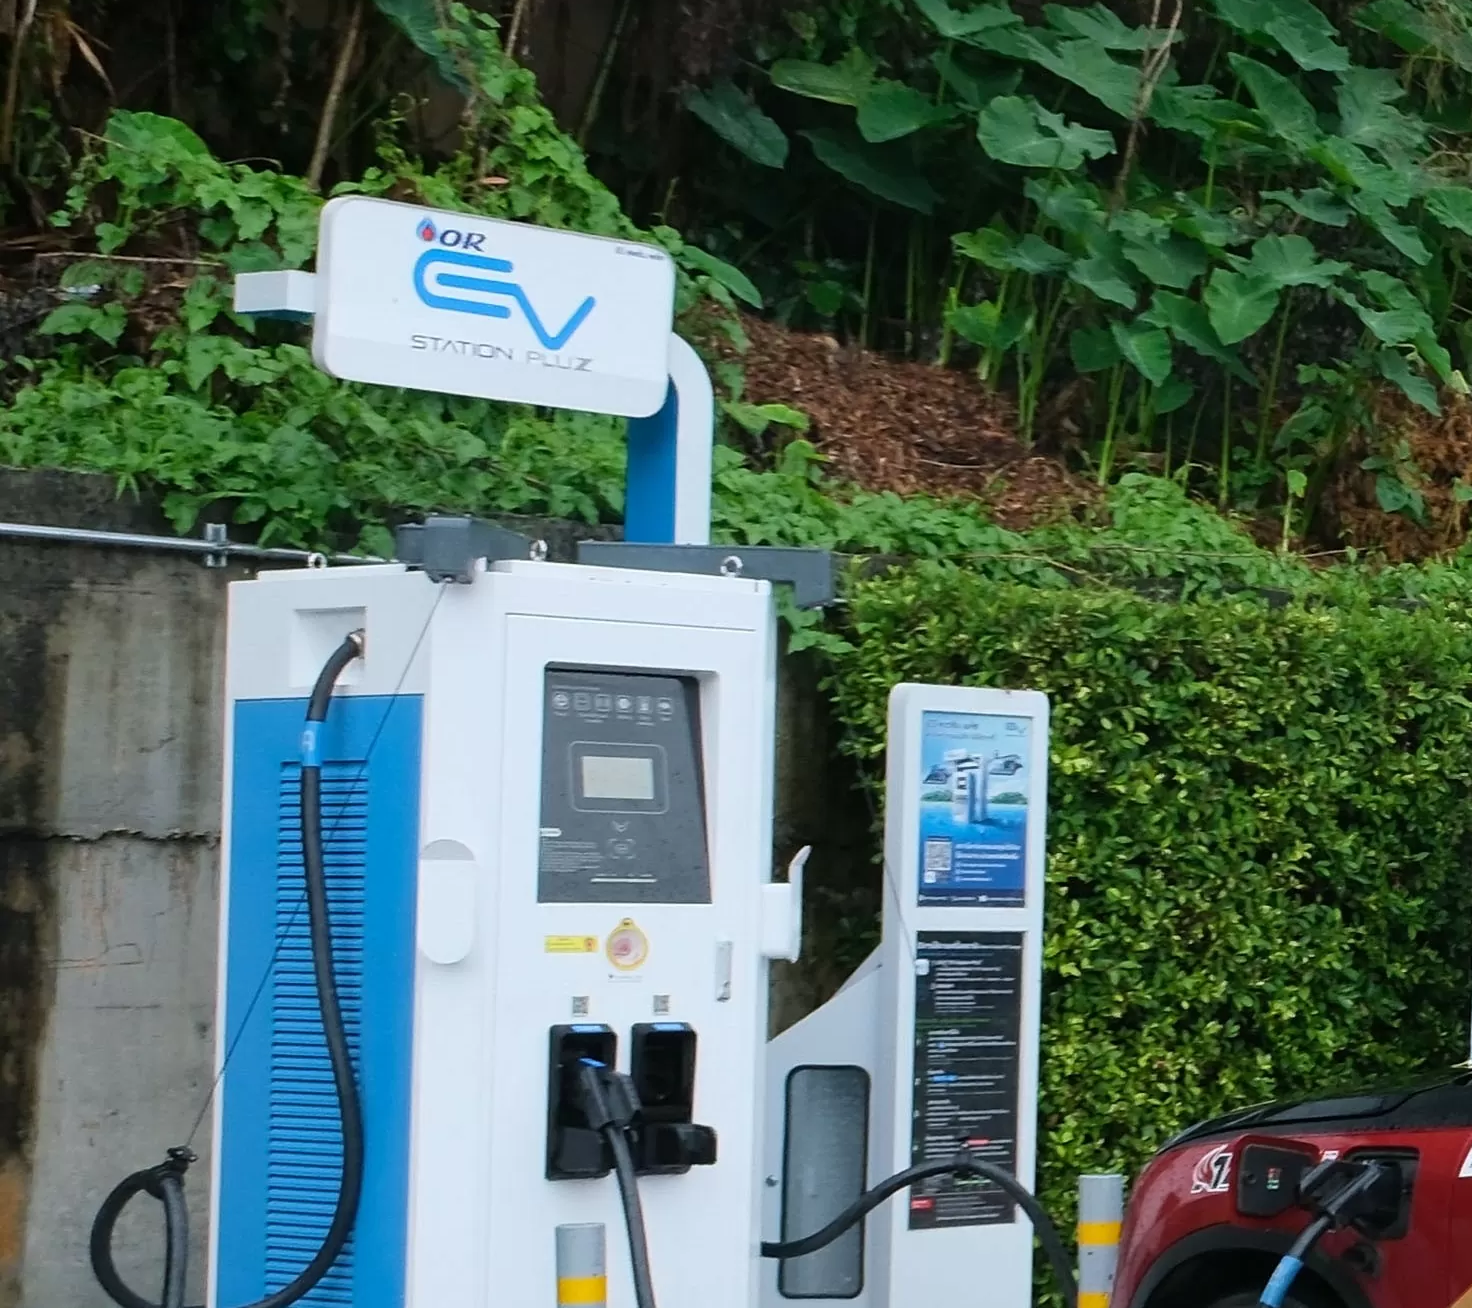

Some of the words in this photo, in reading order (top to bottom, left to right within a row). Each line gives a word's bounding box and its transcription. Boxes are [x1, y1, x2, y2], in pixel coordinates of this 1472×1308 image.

[439, 228, 488, 253] OR
[413, 248, 597, 352] EV
[411, 334, 514, 362] STATION
[525, 350, 594, 373] PLUZ
